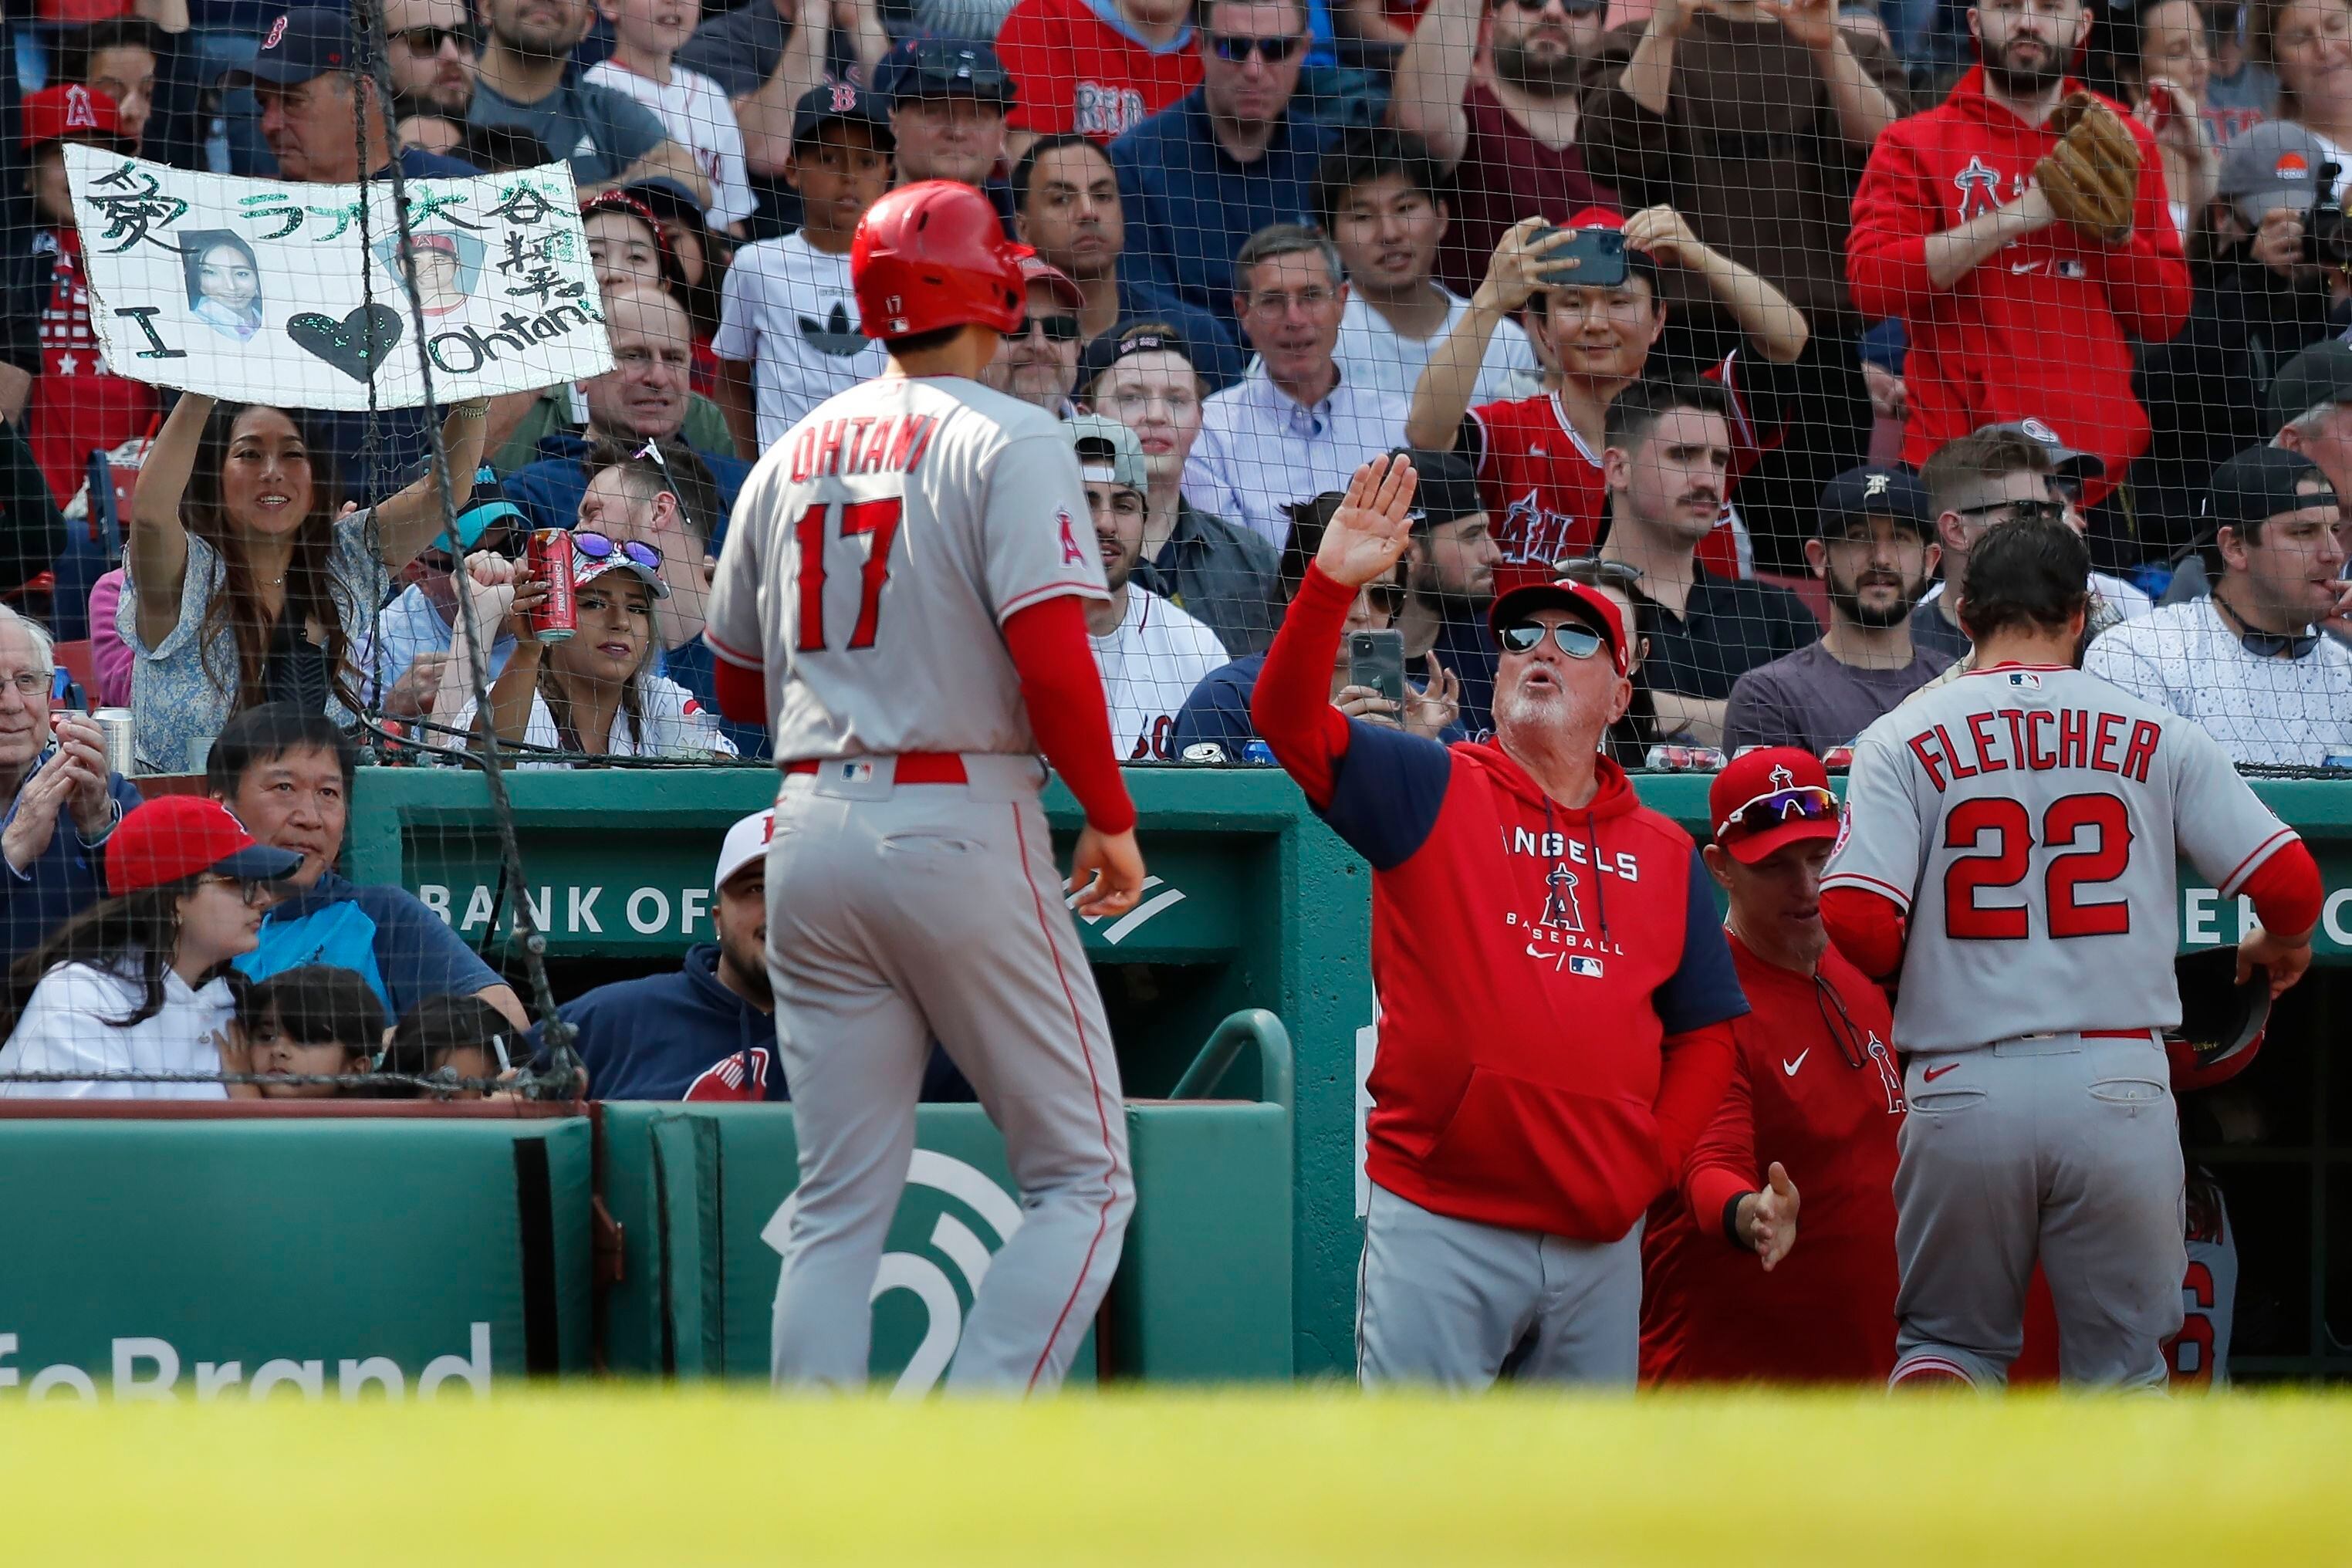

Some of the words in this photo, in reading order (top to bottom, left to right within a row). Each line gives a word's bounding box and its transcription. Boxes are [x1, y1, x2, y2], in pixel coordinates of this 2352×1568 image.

[828, 81, 857, 113] B
[114, 306, 188, 359] I
[885, 295, 903, 315] 17
[790, 414, 940, 484] OHTANI
[796, 496, 903, 653] 17
[1908, 708, 2162, 794] FLETCHER
[1500, 825, 1638, 882] NGELS
[1943, 792, 2136, 940] 22
[419, 884, 603, 933] BANK
[626, 887, 709, 934] OF
